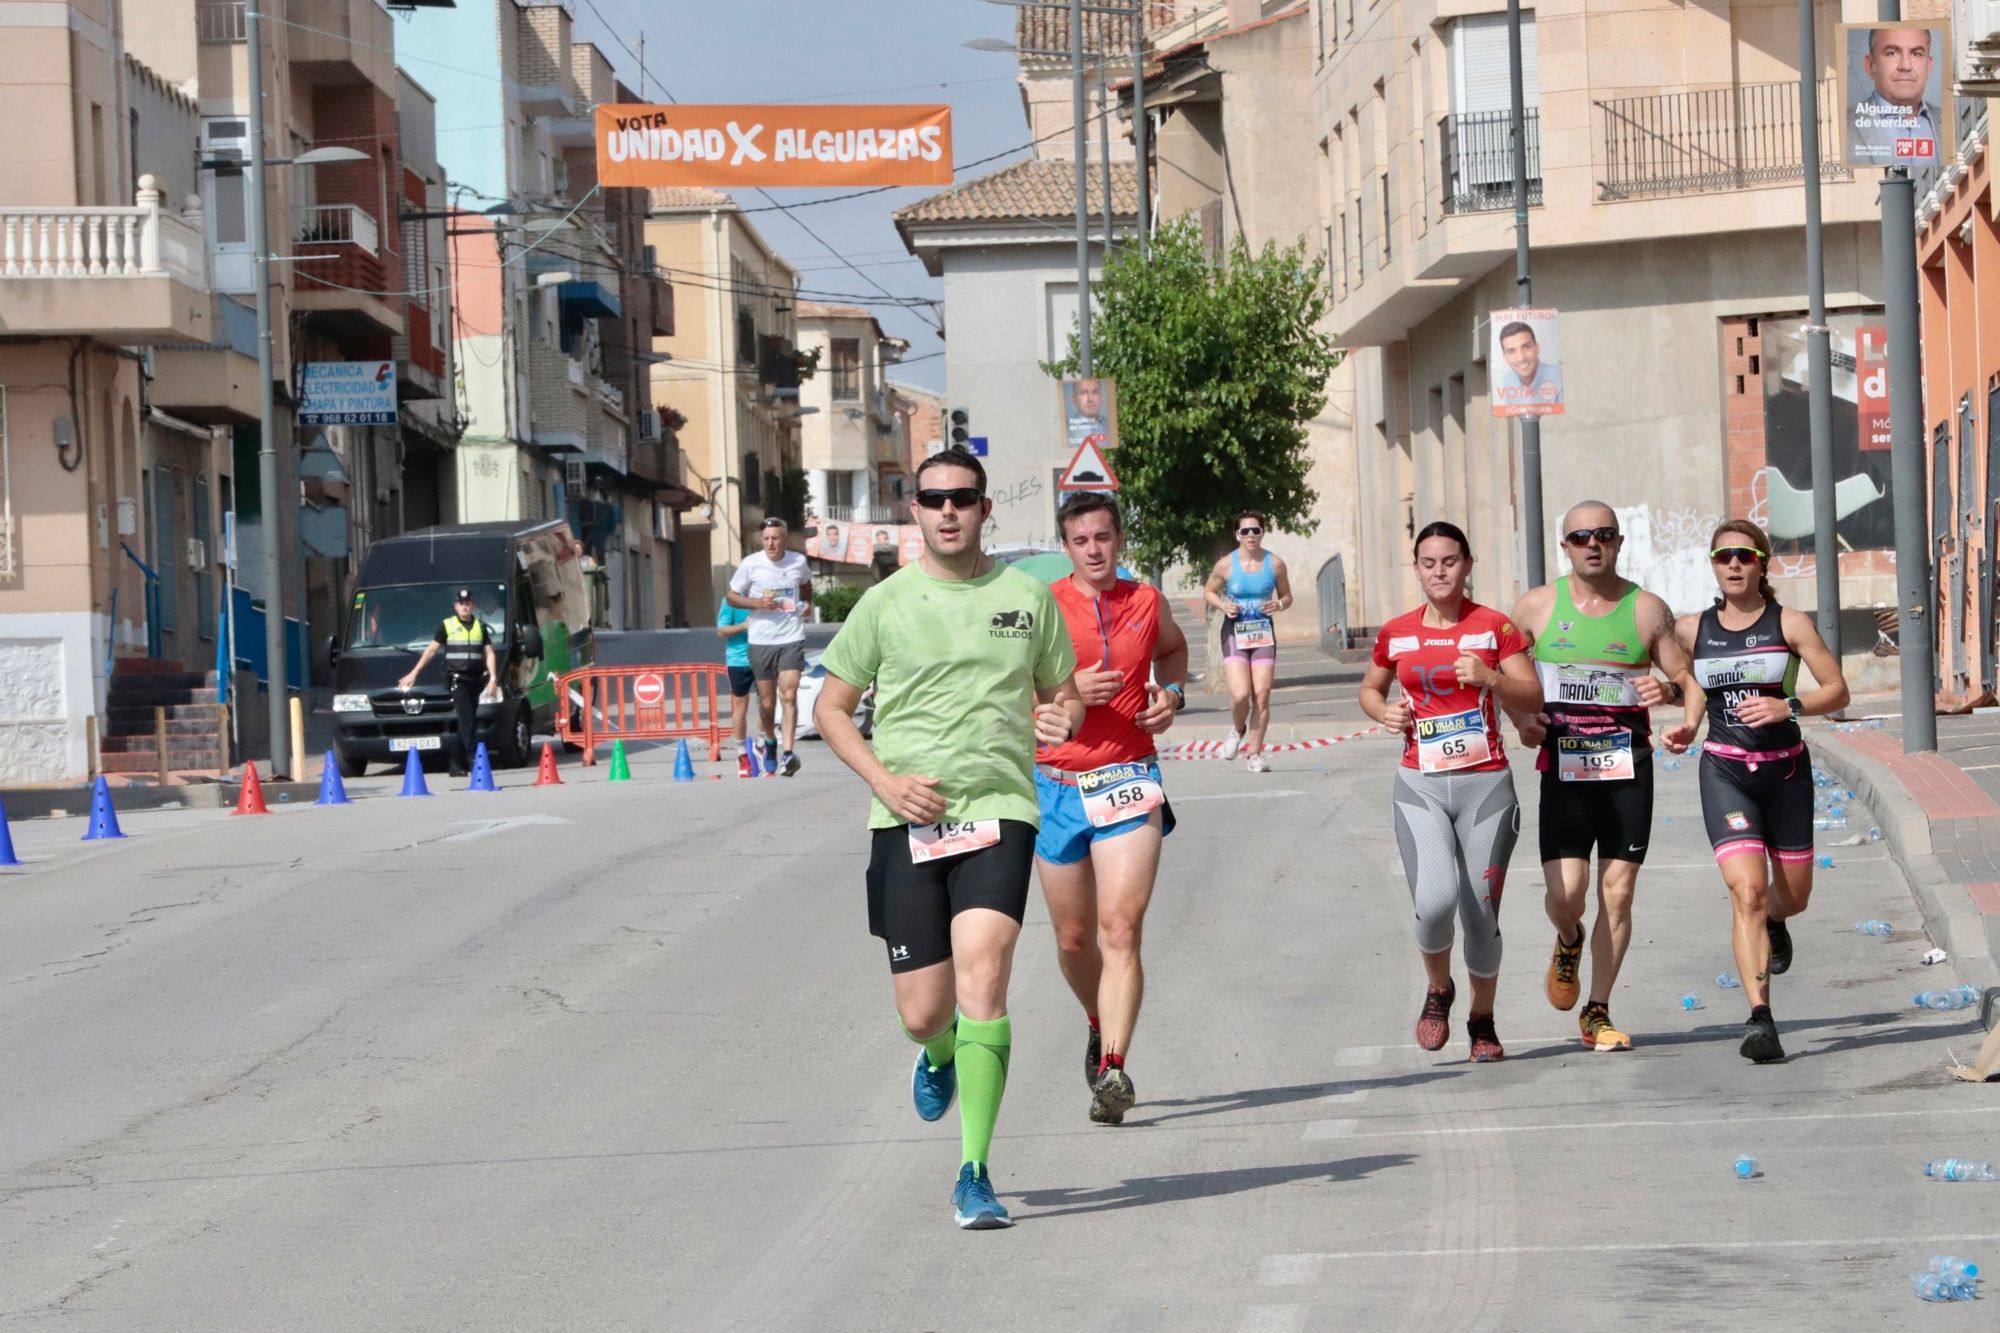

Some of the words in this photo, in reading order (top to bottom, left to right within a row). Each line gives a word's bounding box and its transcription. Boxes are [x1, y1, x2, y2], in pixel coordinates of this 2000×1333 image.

[1855, 102, 1913, 116] Alguazas
[616, 112, 668, 132] VOTA
[1855, 116, 1871, 128] de
[1873, 117, 1921, 128] verdad.
[608, 127, 726, 162] UNIDAD
[725, 121, 767, 166] X
[774, 125, 942, 163] ALGUAZAS
[1497, 386, 1535, 399] VOTA
[339, 397, 345, 409] Y
[348, 396, 392, 409] PINTURA
[322, 413, 340, 423] 968
[344, 413, 357, 422] 62
[360, 413, 371, 422] 01
[376, 413, 388, 422] 18
[988, 630, 1033, 640] TULLIDOS
[1247, 632, 1263, 641] 178
[1442, 739, 1466, 756] 65
[1580, 755, 1614, 767] 105
[1105, 786, 1144, 808] 158
[933, 821, 976, 840] 194
